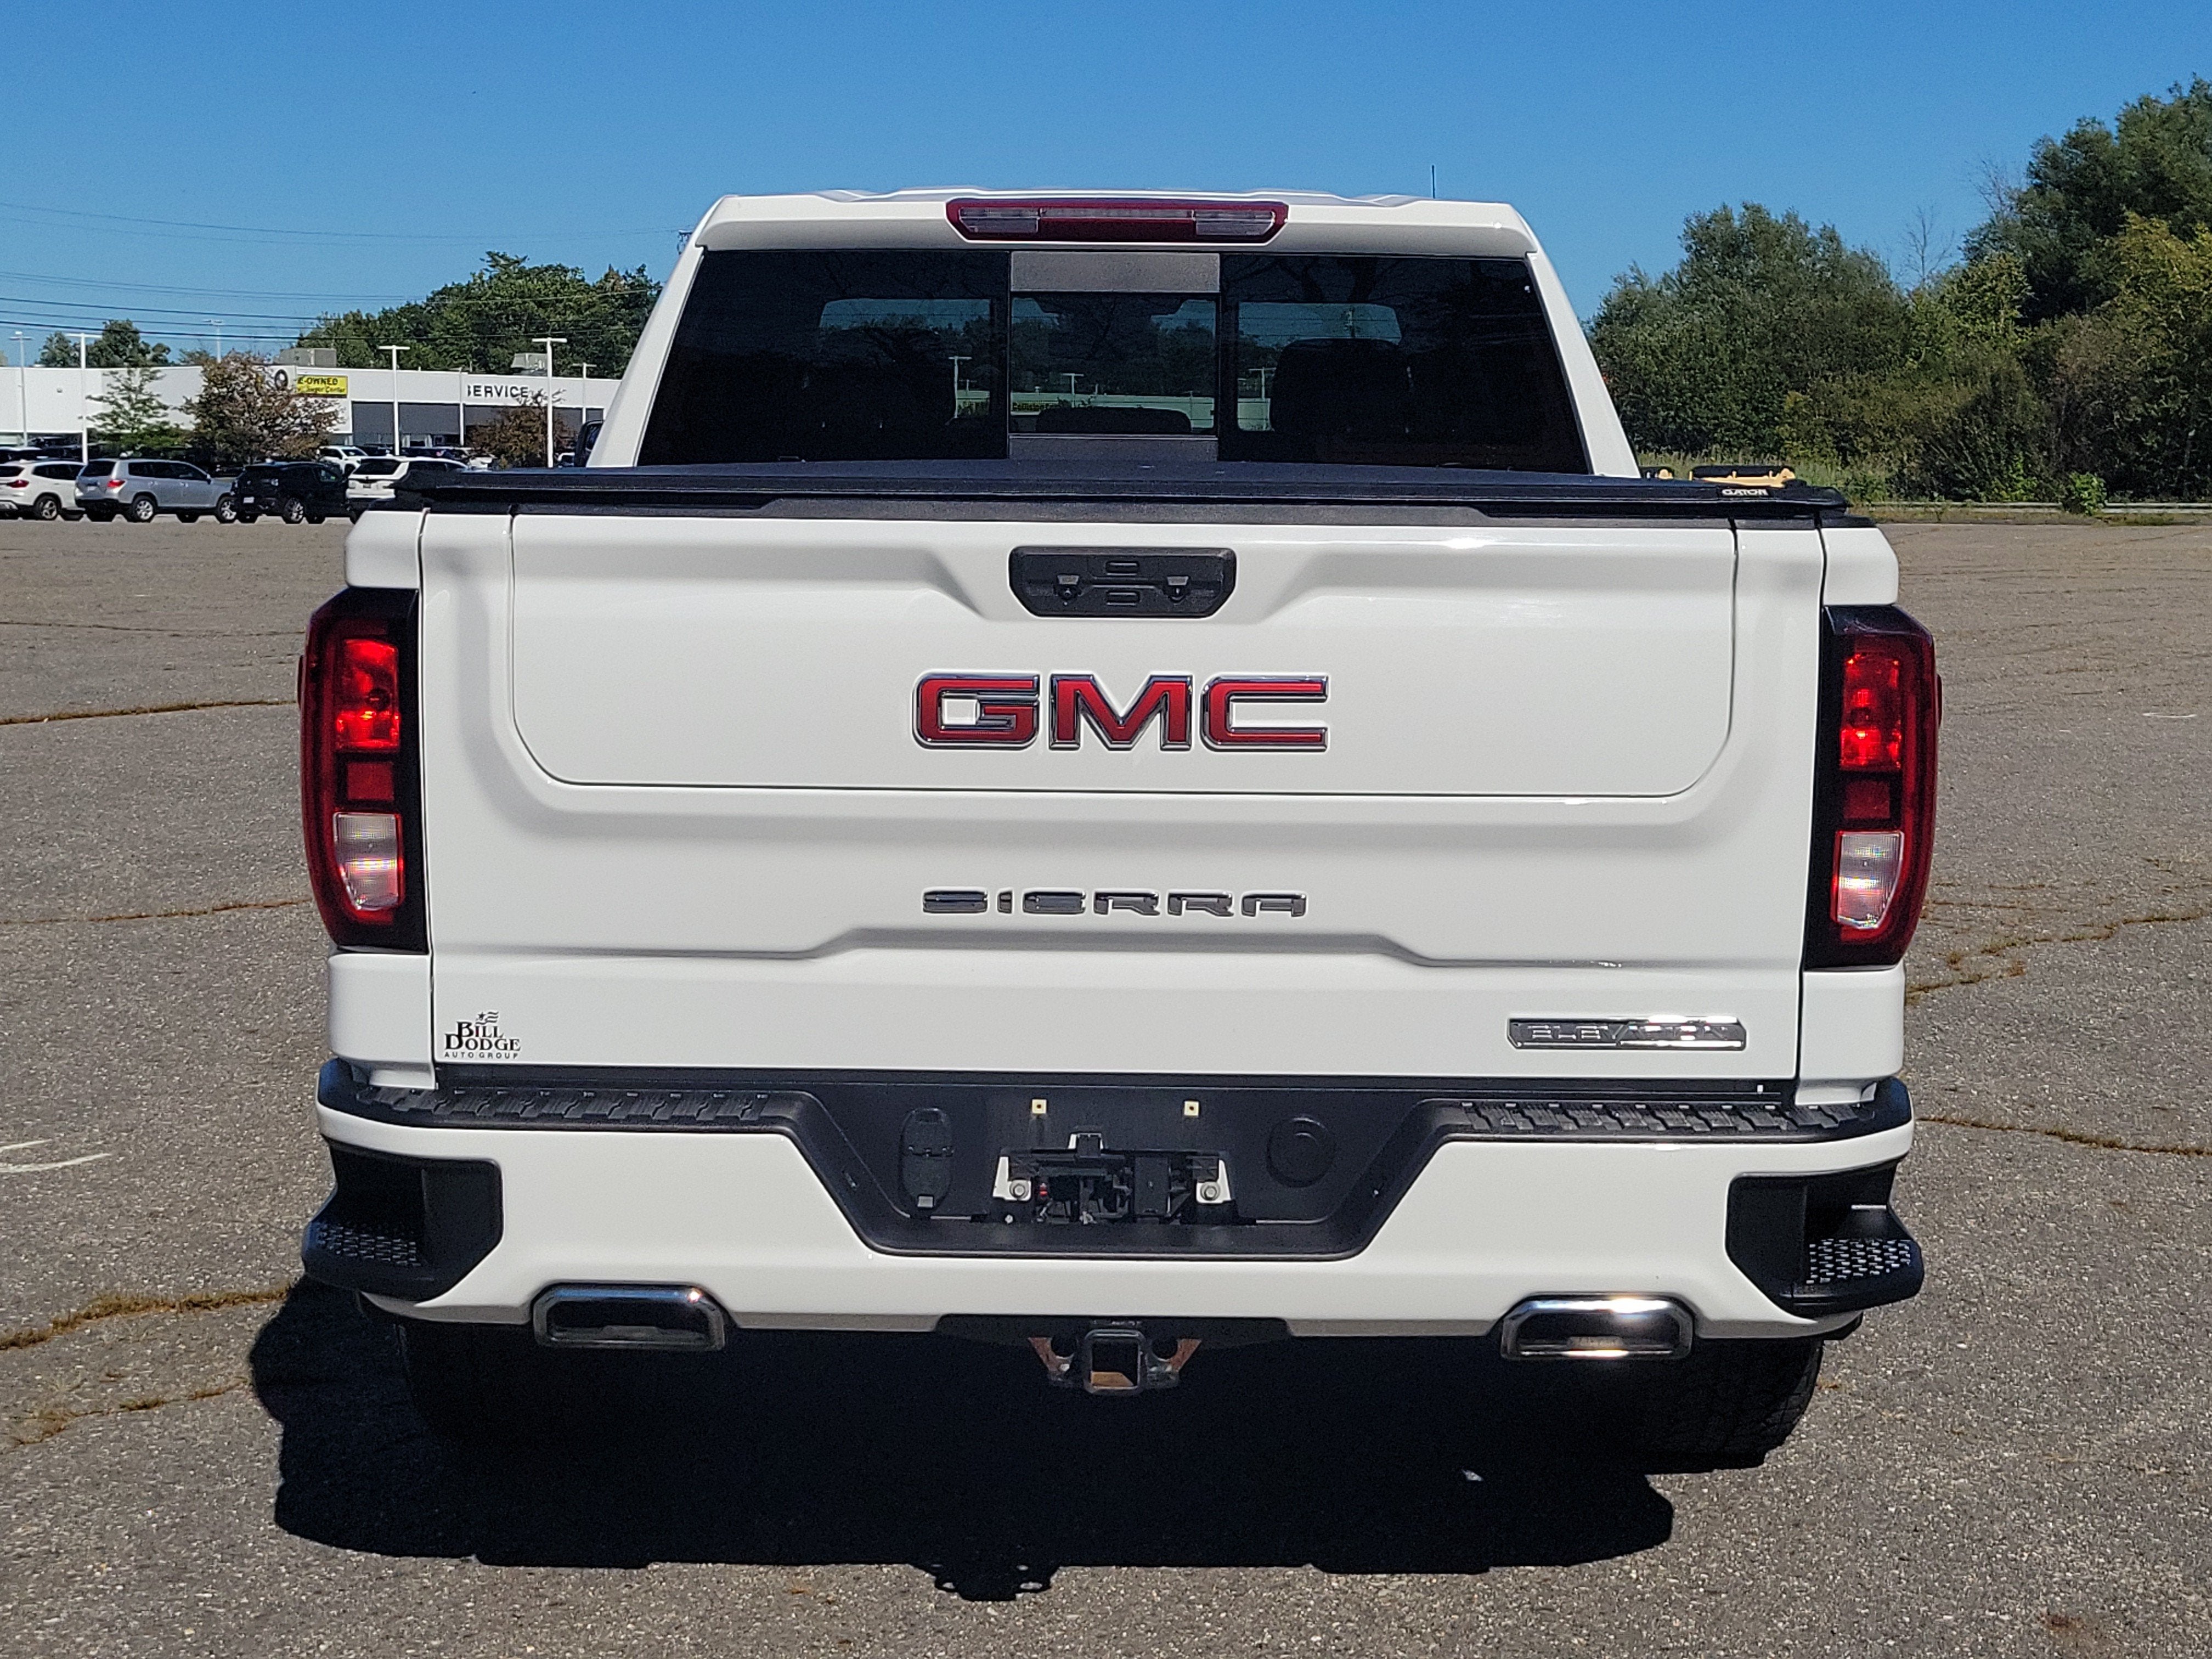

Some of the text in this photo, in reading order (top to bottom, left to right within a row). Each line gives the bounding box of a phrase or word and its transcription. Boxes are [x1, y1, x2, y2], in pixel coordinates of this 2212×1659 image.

[913, 673, 1328, 752] GMC
[923, 887, 1307, 917] SIERRA
[444, 1033, 521, 1051] DODGE
[457, 1021, 505, 1039] BILL
